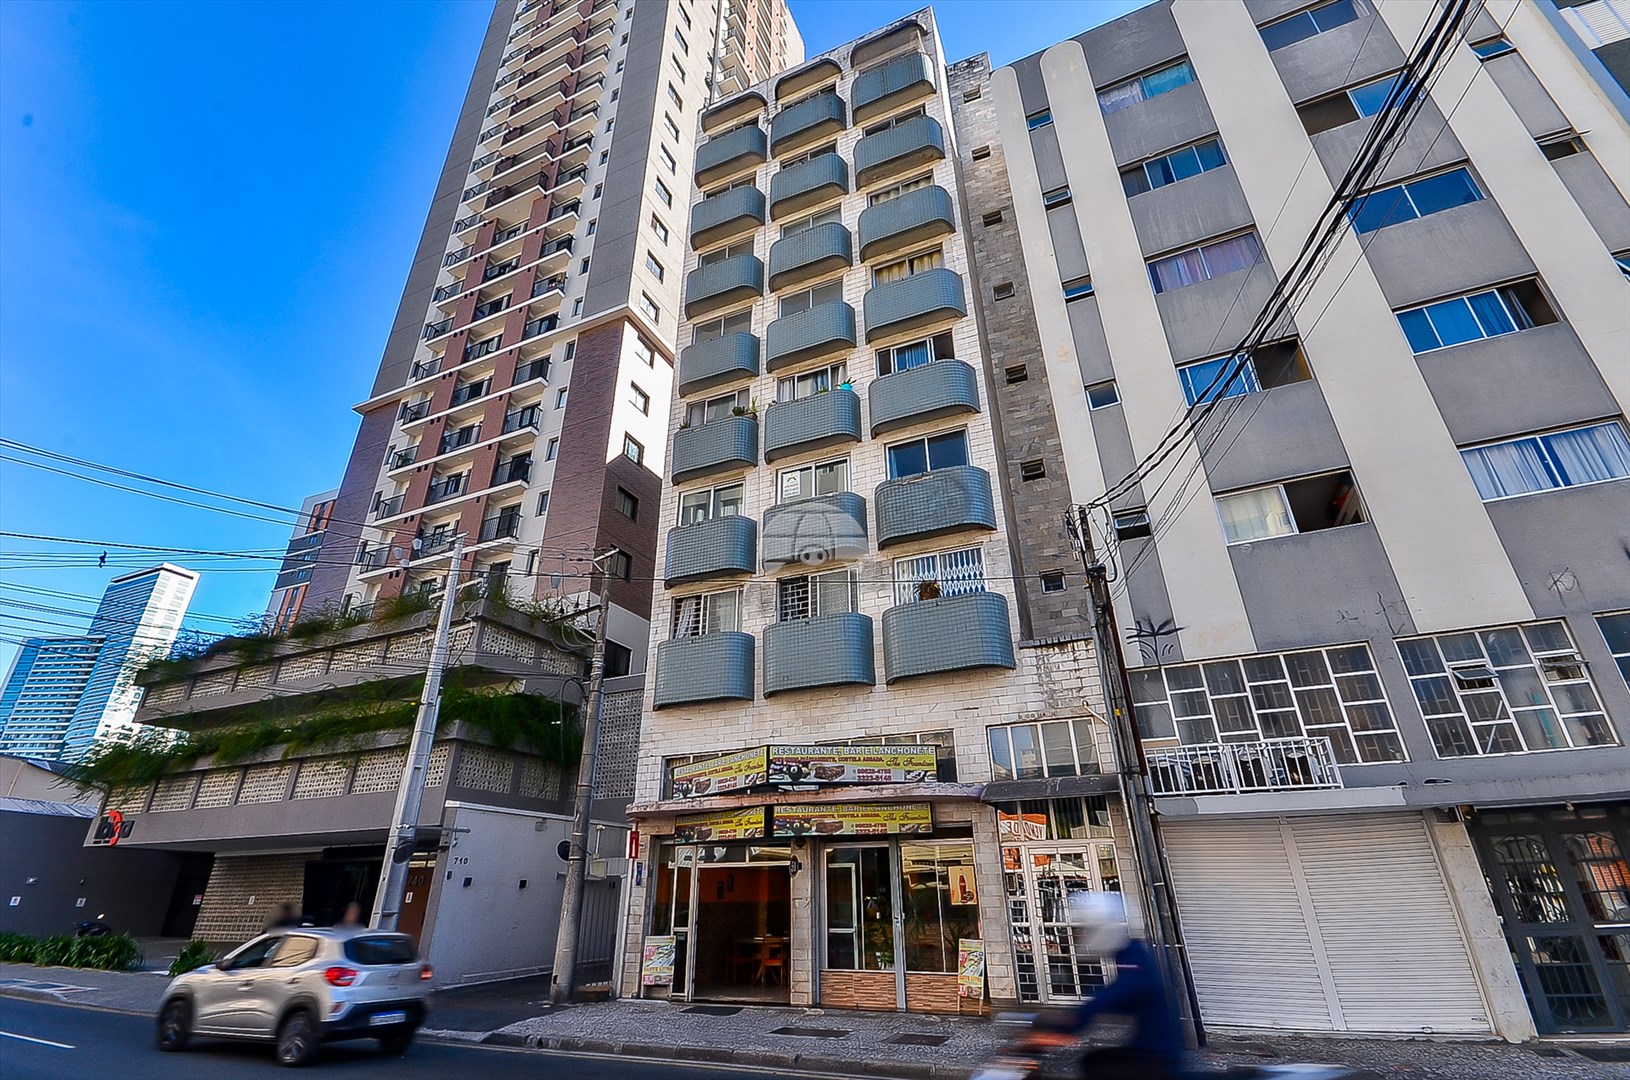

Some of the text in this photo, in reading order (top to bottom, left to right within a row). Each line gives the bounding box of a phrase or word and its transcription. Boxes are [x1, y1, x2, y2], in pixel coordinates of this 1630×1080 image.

[772, 746, 934, 756] RESTAURANTE, BAR E LANCHONETE
[886, 756, 901, 767] The
[775, 804, 840, 814] RESTAURANTE,
[842, 804, 860, 812] BAR
[454, 856, 469, 865] 710
